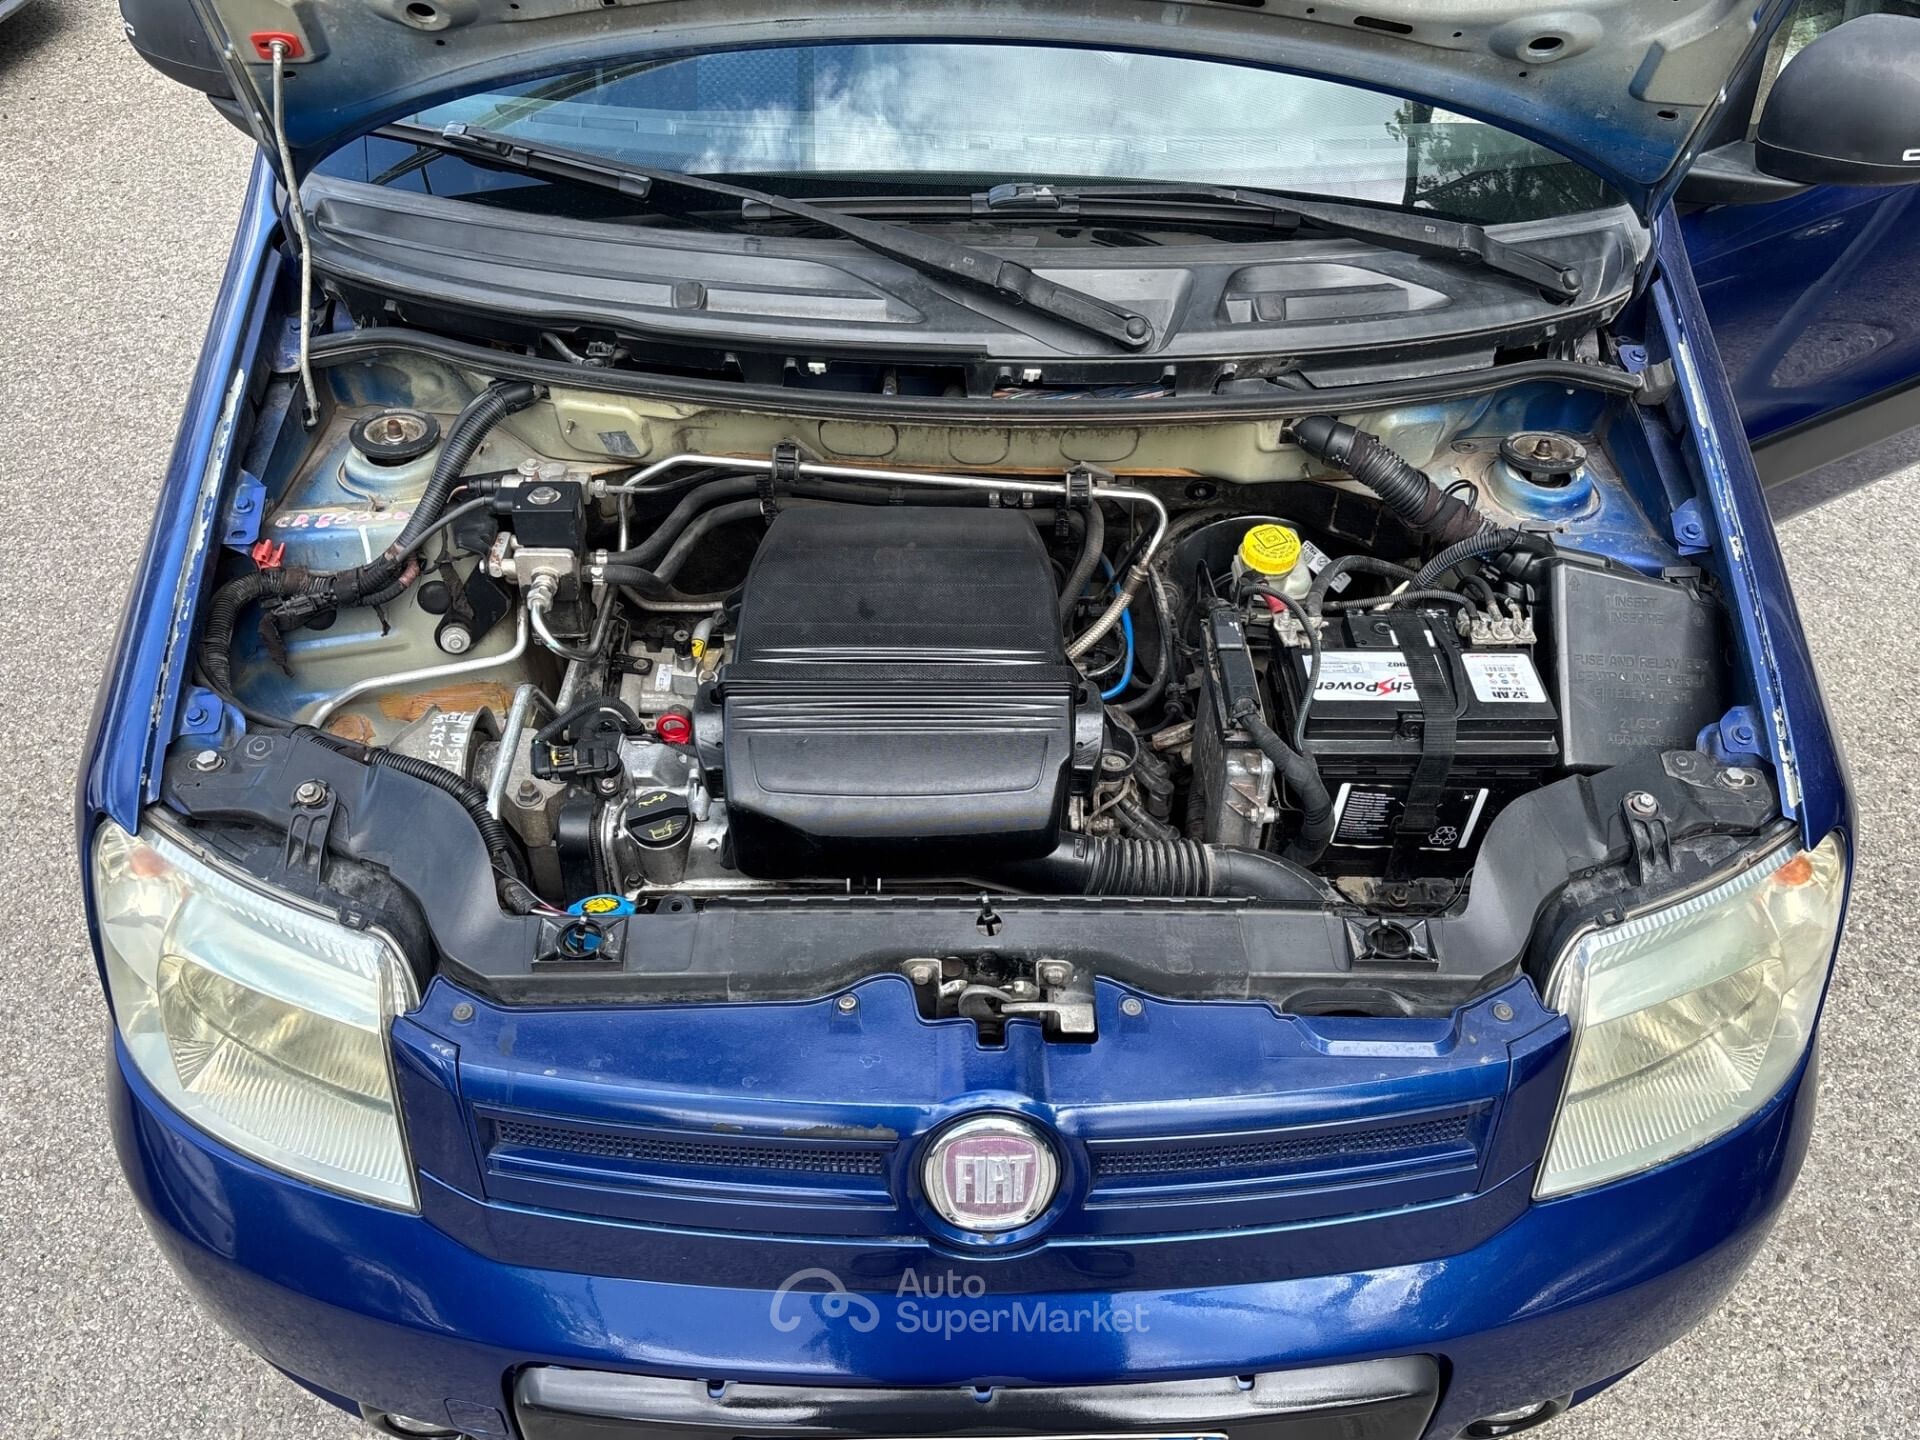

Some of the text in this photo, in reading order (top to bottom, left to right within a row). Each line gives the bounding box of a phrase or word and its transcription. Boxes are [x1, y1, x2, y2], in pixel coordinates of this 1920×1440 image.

[1614, 595, 1658, 609] INSERT
[1573, 654, 1604, 666] FUSE
[1609, 655, 1635, 667] AND
[1639, 656, 1680, 669] RELAY
[954, 1152, 1032, 1205] FIAT
